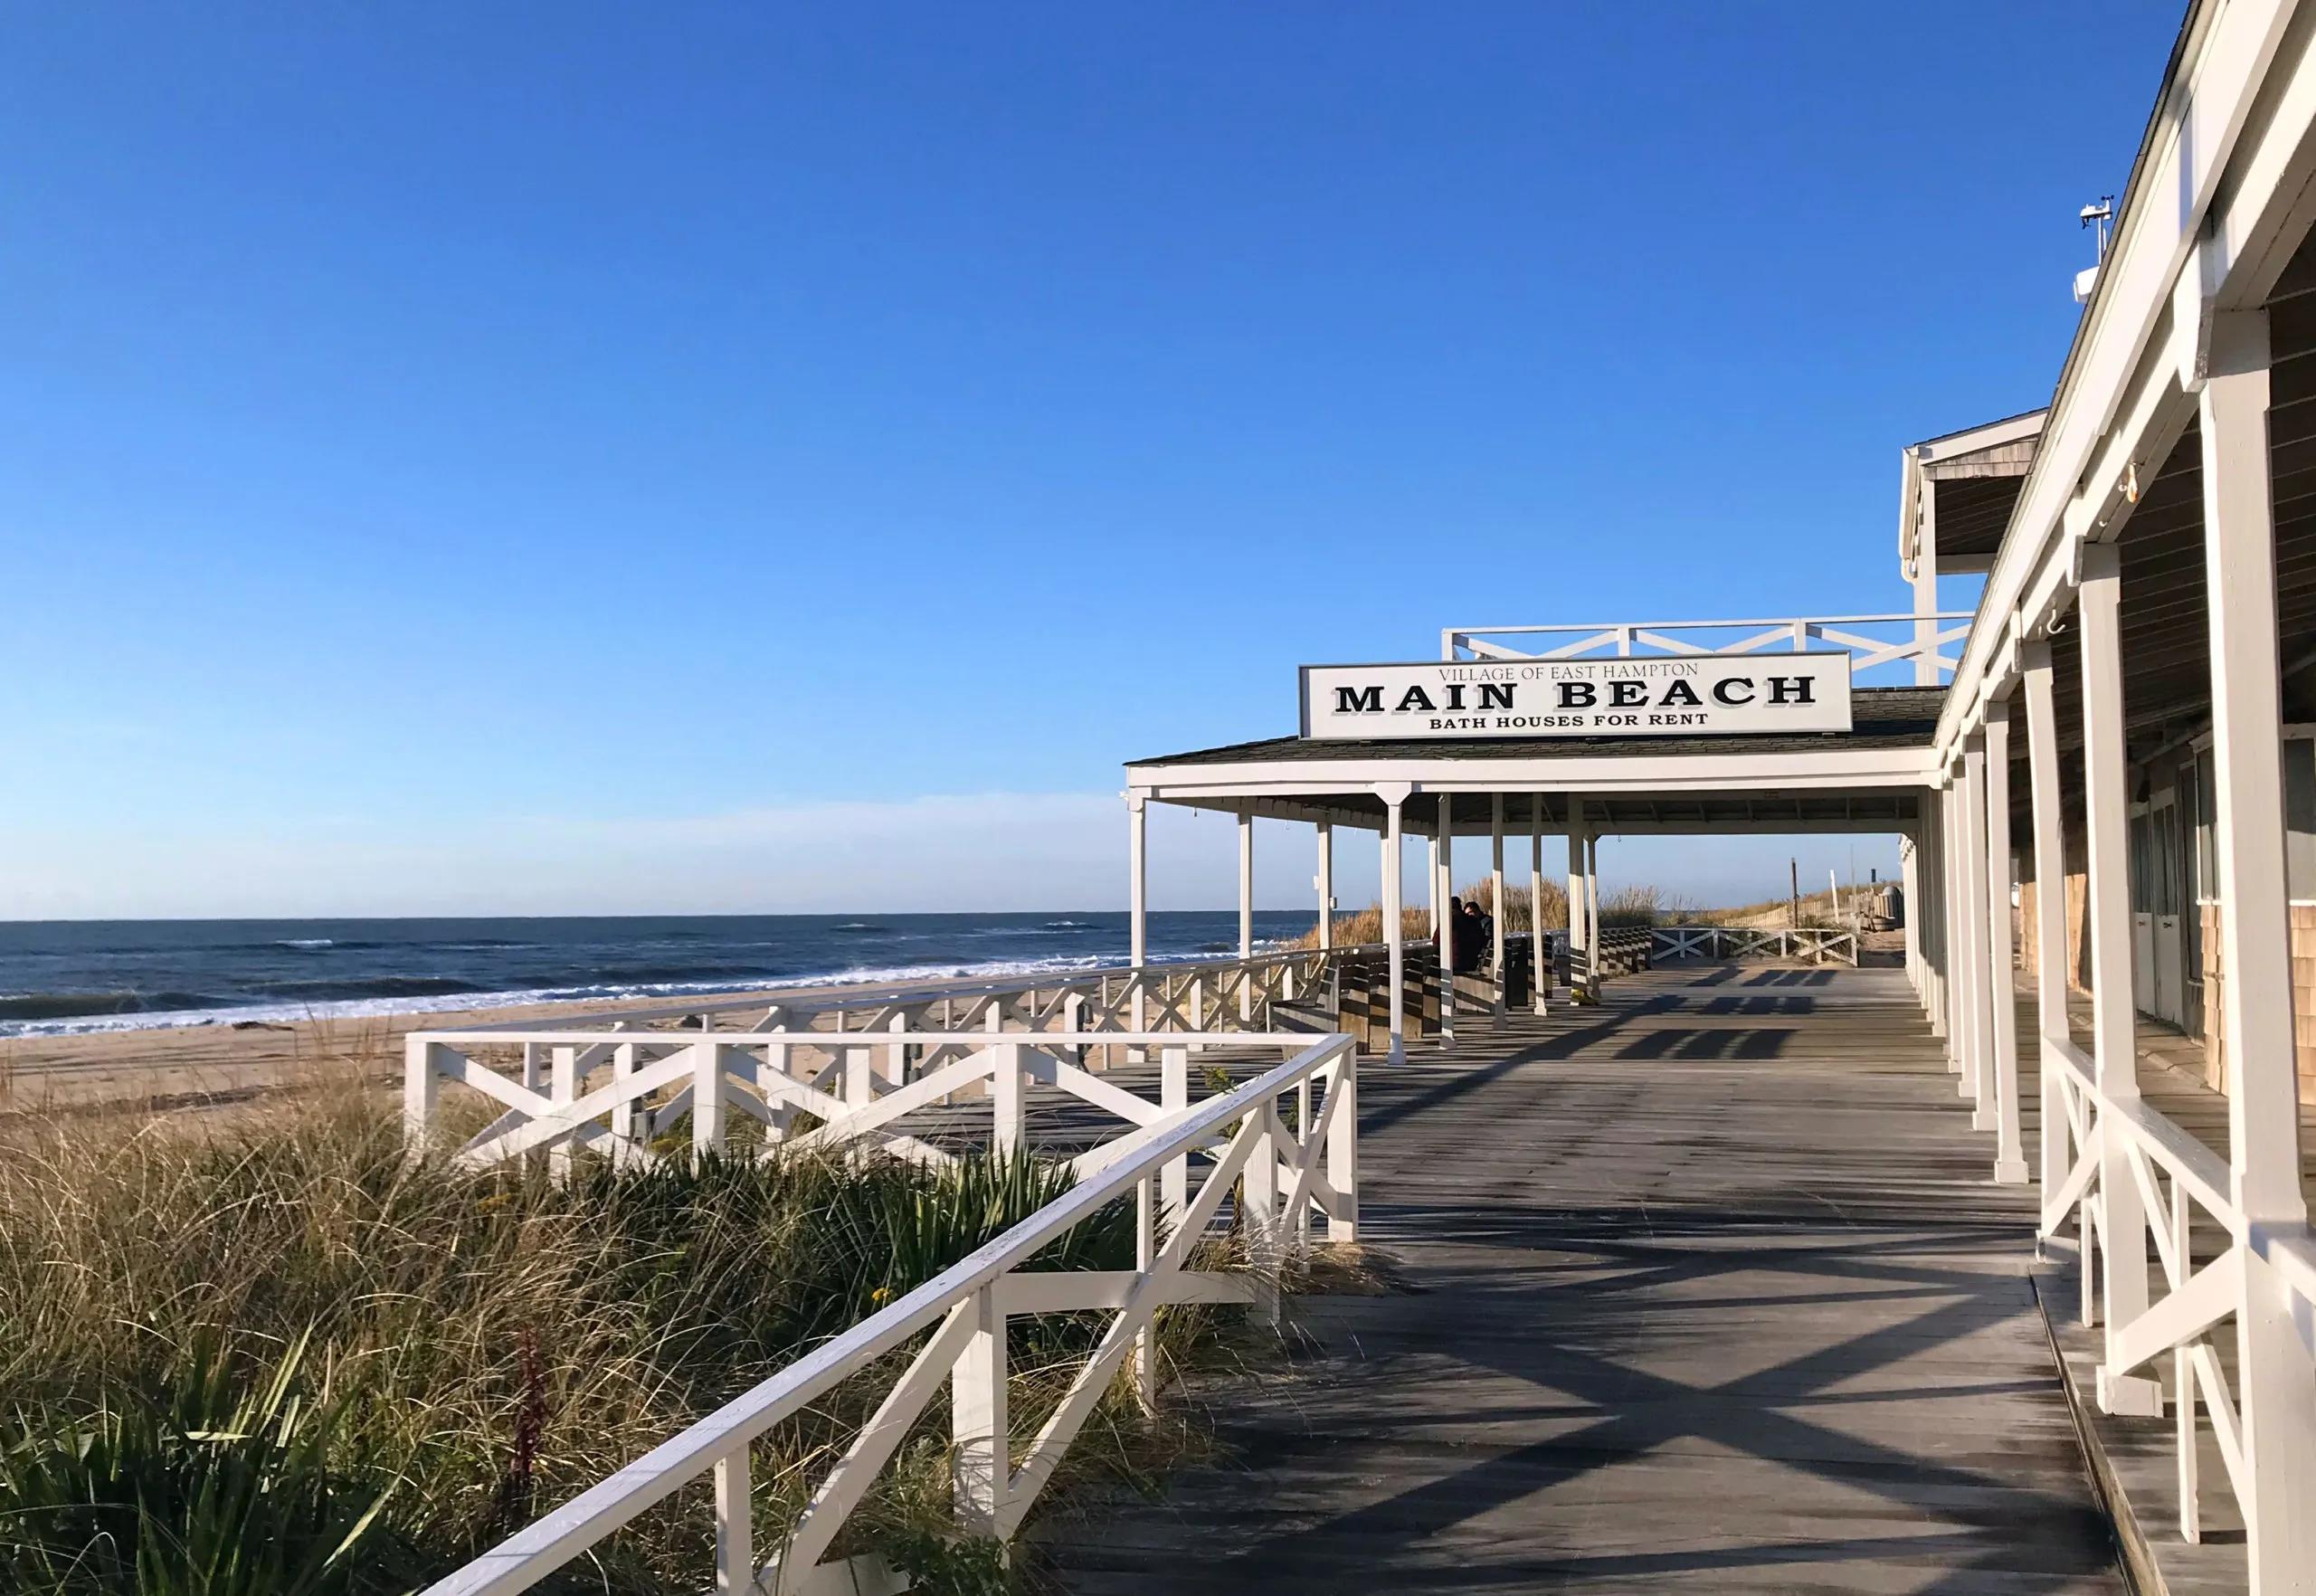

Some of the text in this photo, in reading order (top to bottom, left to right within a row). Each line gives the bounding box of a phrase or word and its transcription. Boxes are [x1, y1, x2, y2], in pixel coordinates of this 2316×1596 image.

[1438, 663, 1699, 681] VILLAGE OF EAST HAMPTON
[1333, 677, 1816, 714] MAIN BEACH
[1429, 713, 1708, 729] BATH HOUSES FOR RENT
